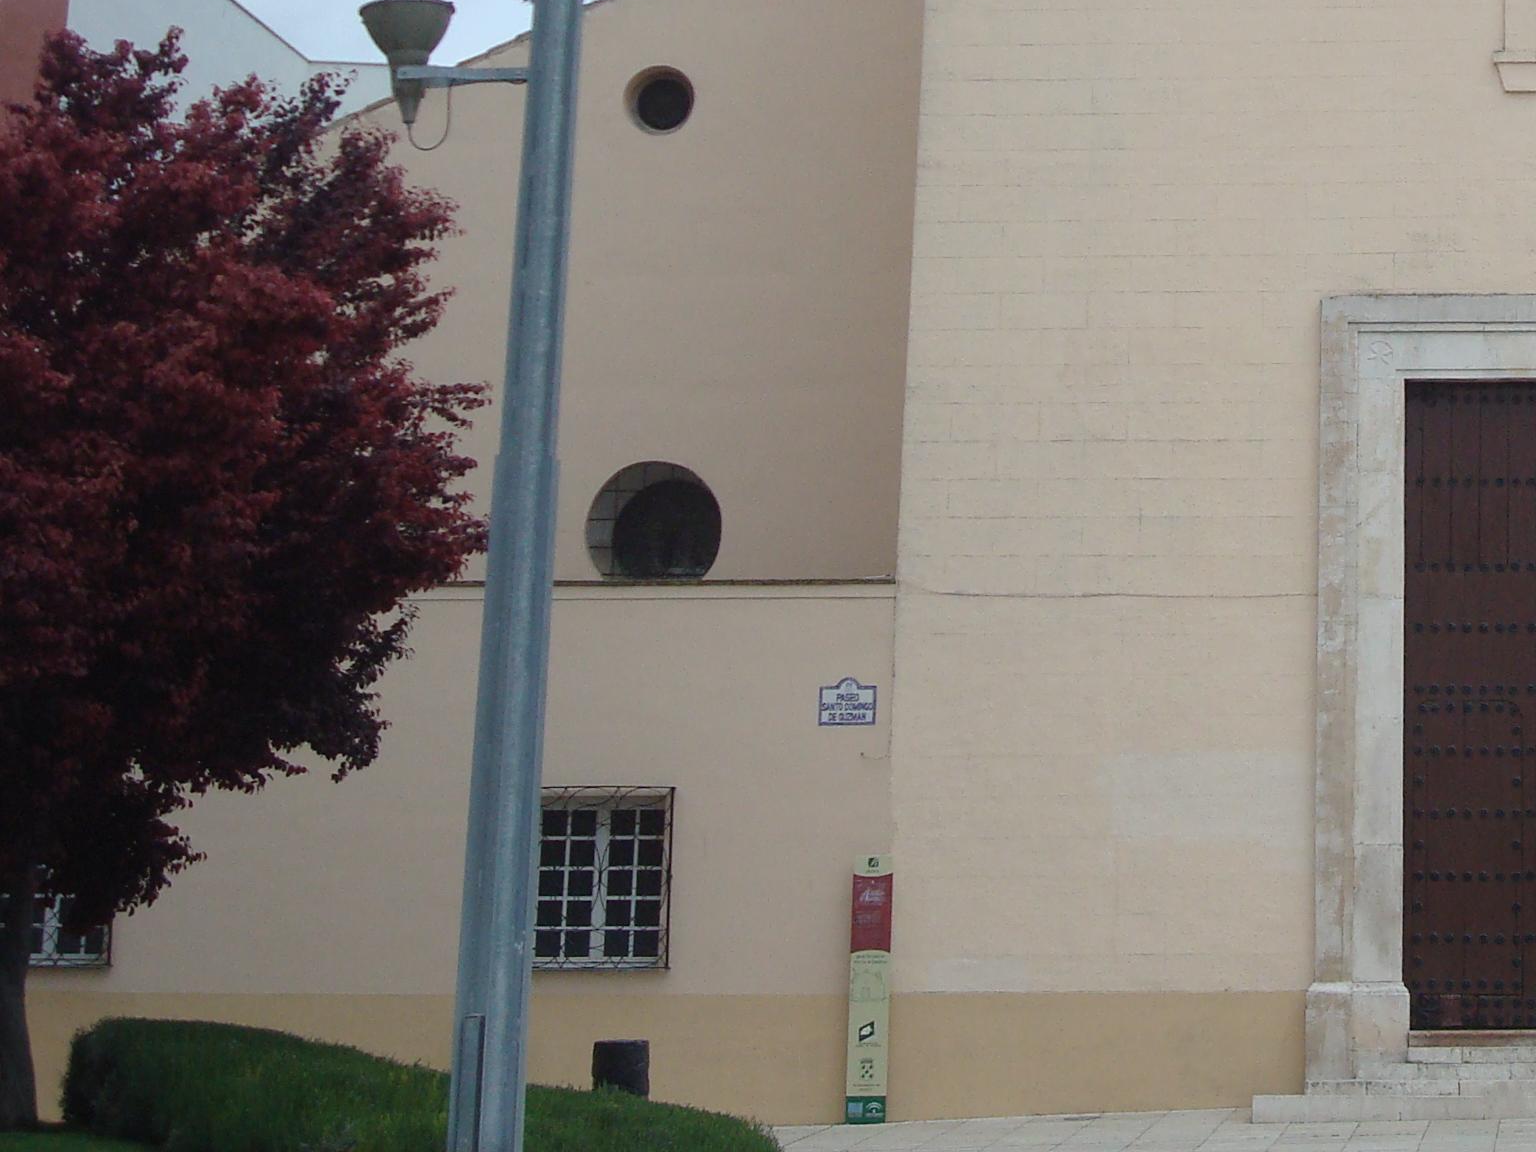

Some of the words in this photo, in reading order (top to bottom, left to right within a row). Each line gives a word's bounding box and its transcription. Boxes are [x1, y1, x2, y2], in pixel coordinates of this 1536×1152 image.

[836, 693, 860, 702] PASEO
[821, 702, 843, 711] SANTO
[844, 702, 873, 711] DOMINGO
[828, 712, 837, 721] DE
